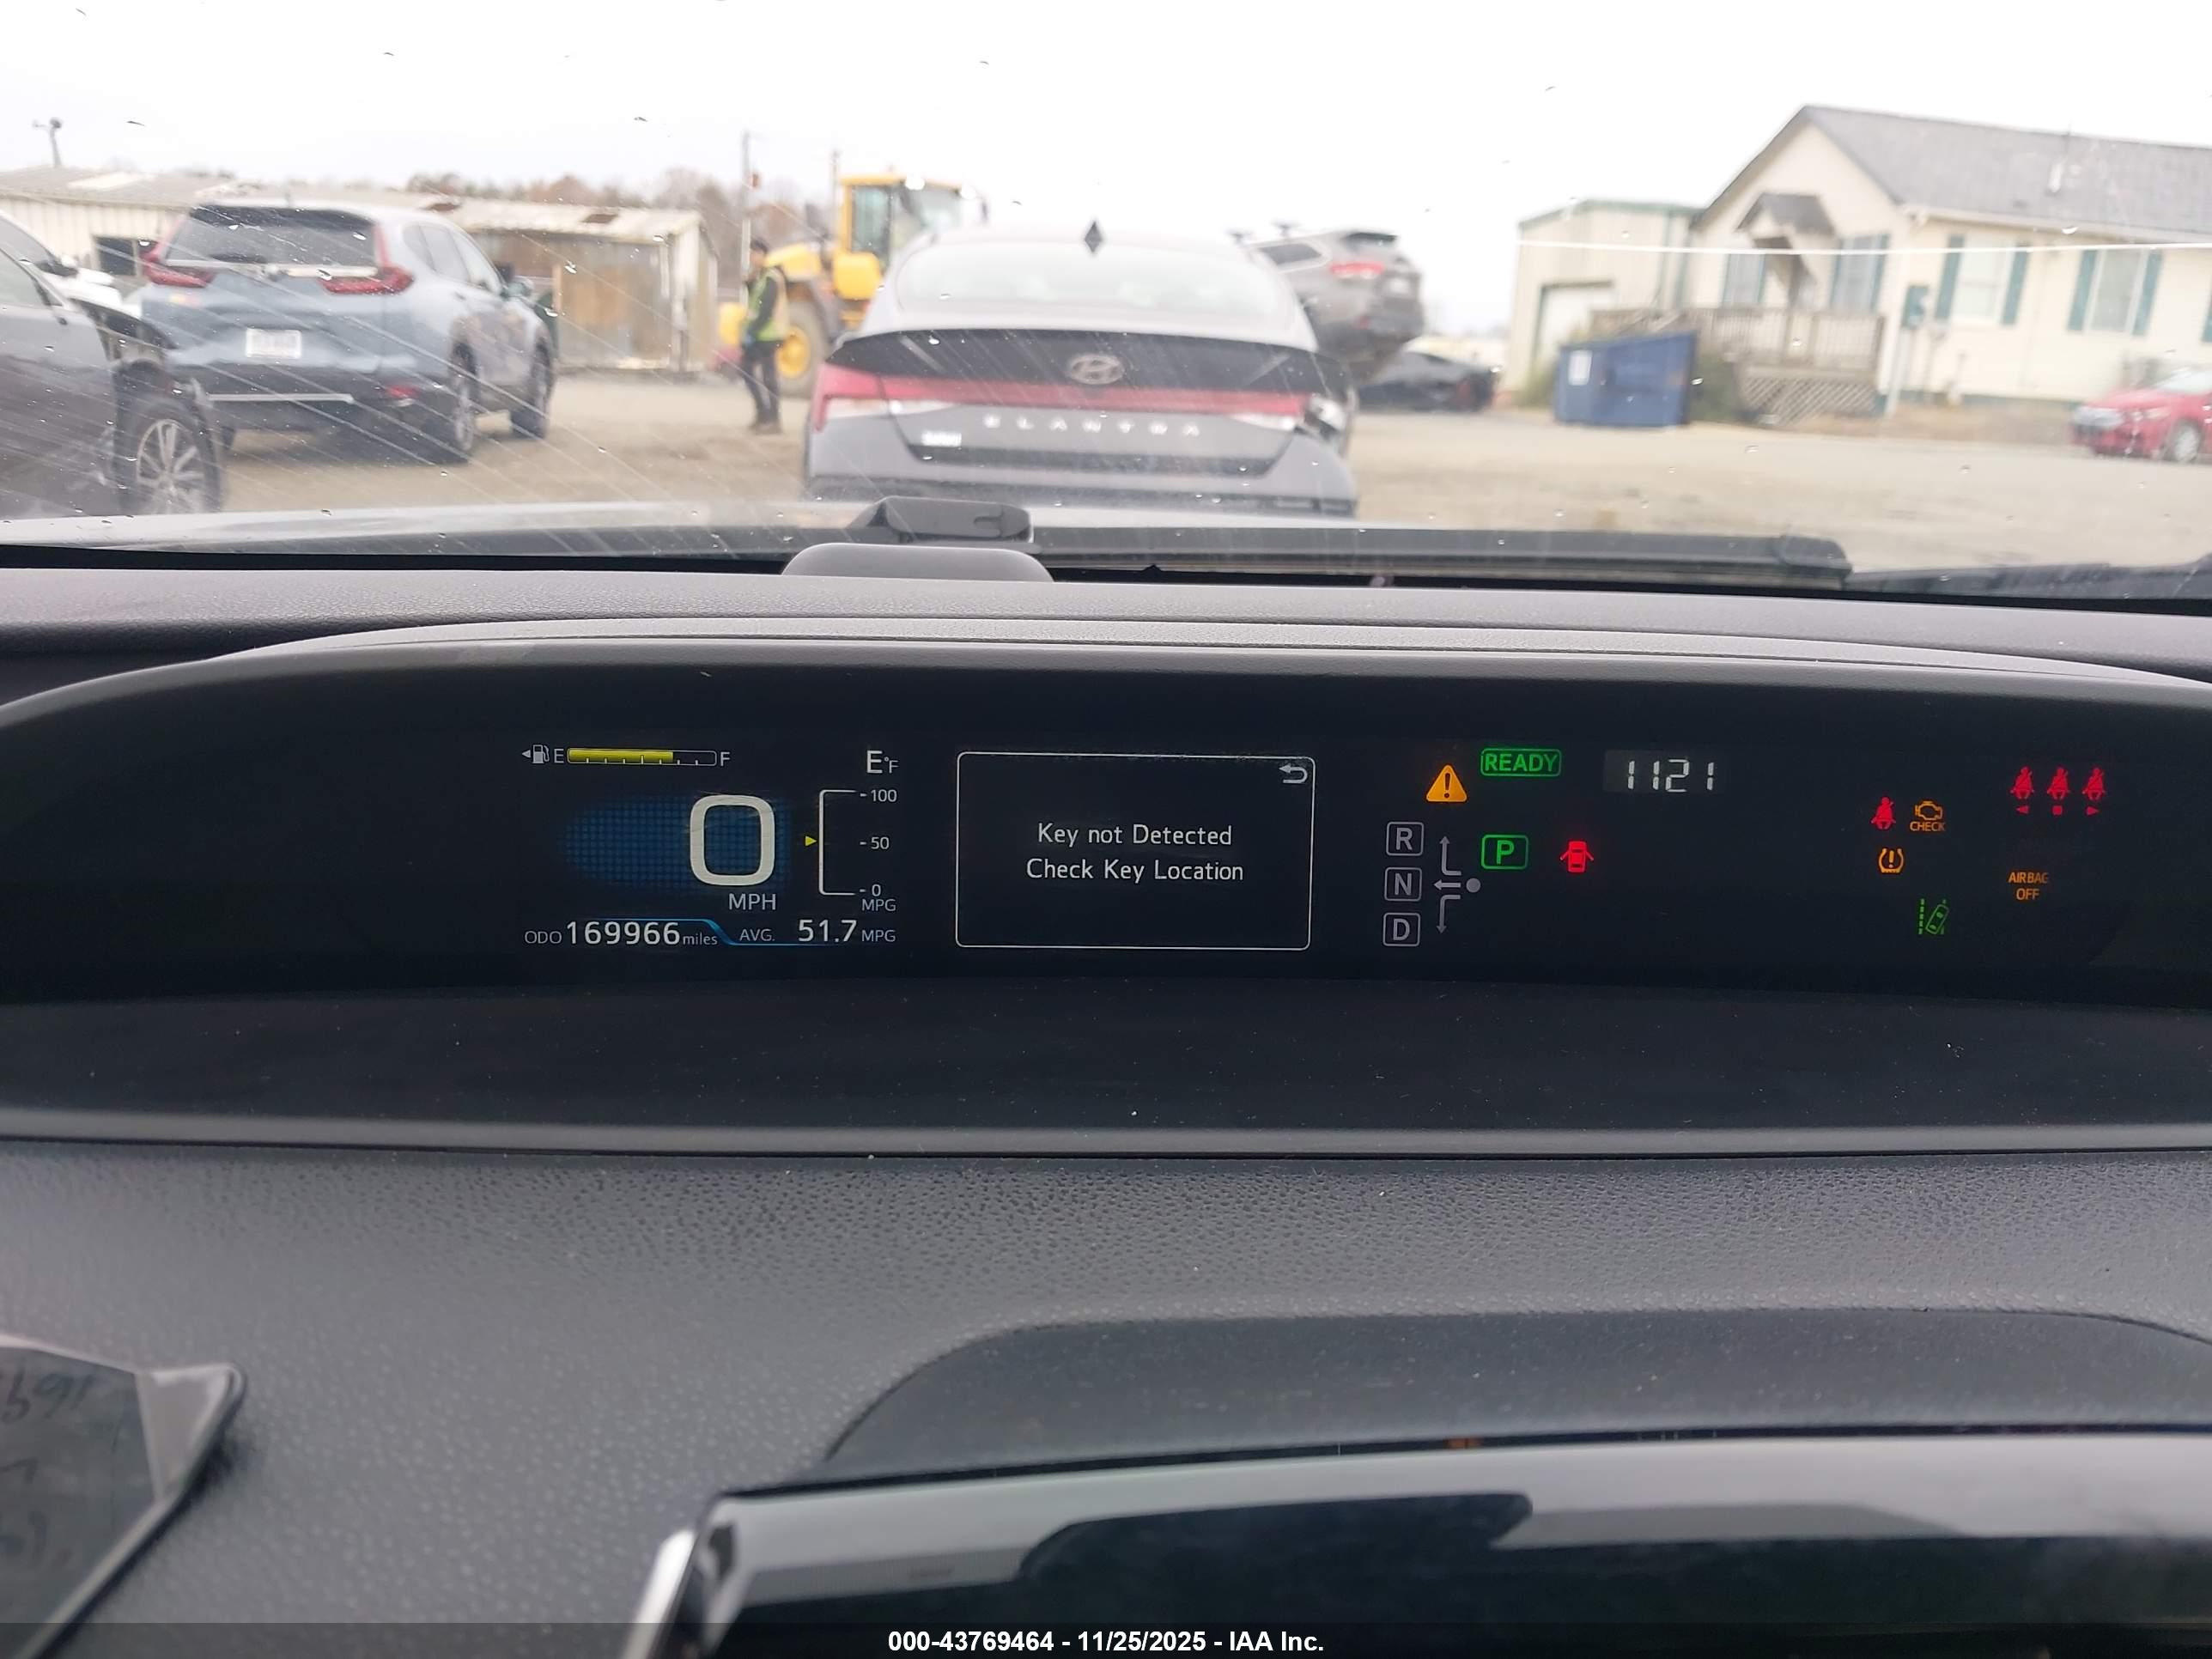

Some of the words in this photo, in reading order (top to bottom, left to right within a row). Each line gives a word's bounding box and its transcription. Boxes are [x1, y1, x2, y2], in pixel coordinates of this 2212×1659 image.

[554, 748, 564, 763] E
[720, 751, 731, 767] F
[1485, 753, 1558, 772] READY
[1037, 822, 1079, 848] Key
[1088, 826, 1123, 844] not
[1133, 823, 1232, 846] Detected
[1909, 821, 1946, 832] CHECK
[689, 794, 776, 887] 0
[1395, 827, 1413, 851] R
[1496, 839, 1515, 865] P
[1026, 858, 1095, 879] Check
[1104, 859, 1146, 884] Key
[1154, 860, 1244, 881] Location
[1394, 872, 1413, 896] N
[2015, 887, 2040, 901] OFF
[728, 892, 777, 911] MPH
[861, 898, 897, 912] MPG
[524, 930, 562, 945] ODO
[566, 921, 680, 945] 169966
[683, 932, 719, 946] miles
[739, 928, 775, 943] AVG.
[798, 919, 858, 943] 51.7
[861, 929, 896, 943] MPG
[1393, 918, 1411, 941] D
